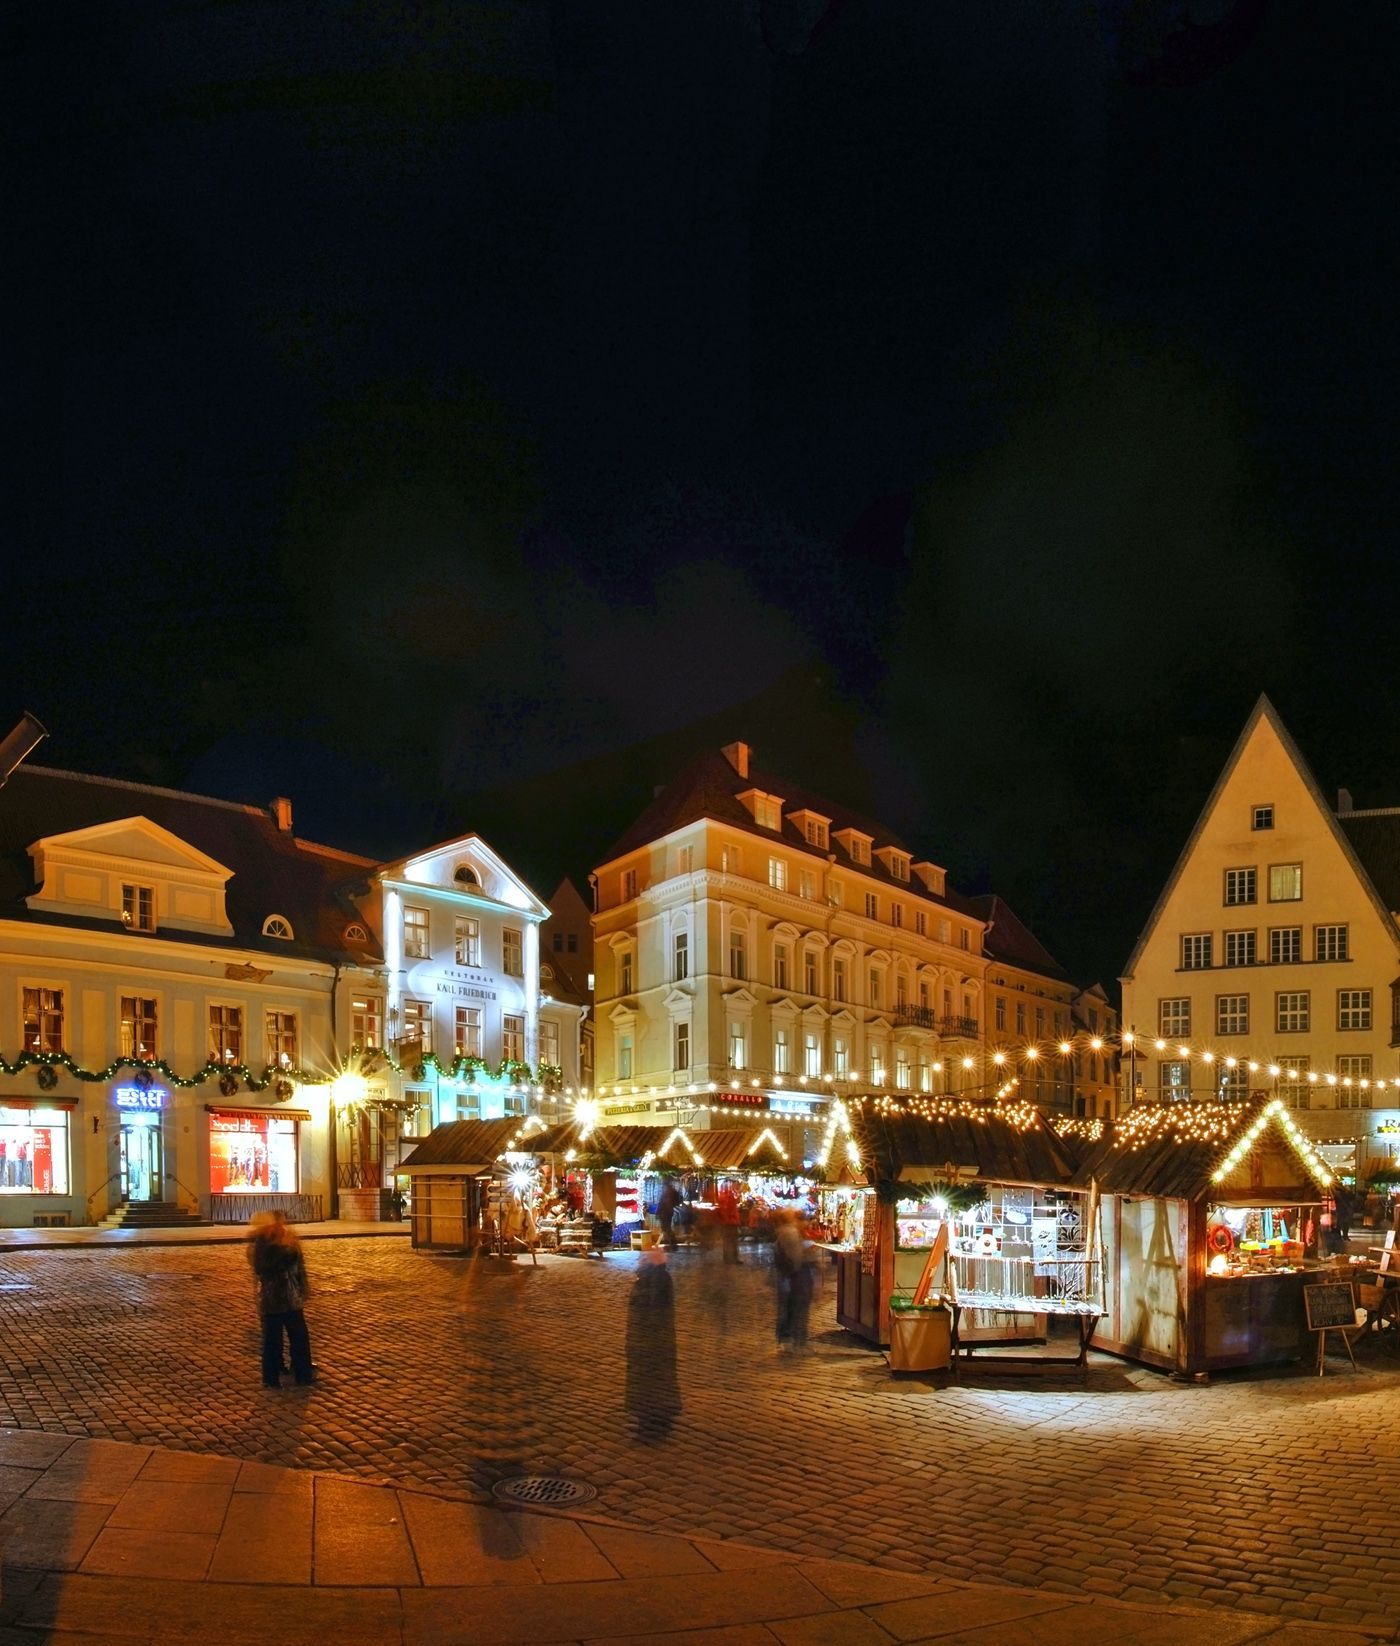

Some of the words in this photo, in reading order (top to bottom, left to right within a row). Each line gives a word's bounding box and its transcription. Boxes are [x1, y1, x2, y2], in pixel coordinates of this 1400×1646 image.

[437, 982, 456, 995] KARL
[458, 986, 497, 1001] FRIEDRICH
[720, 1094, 762, 1103] CORALLO
